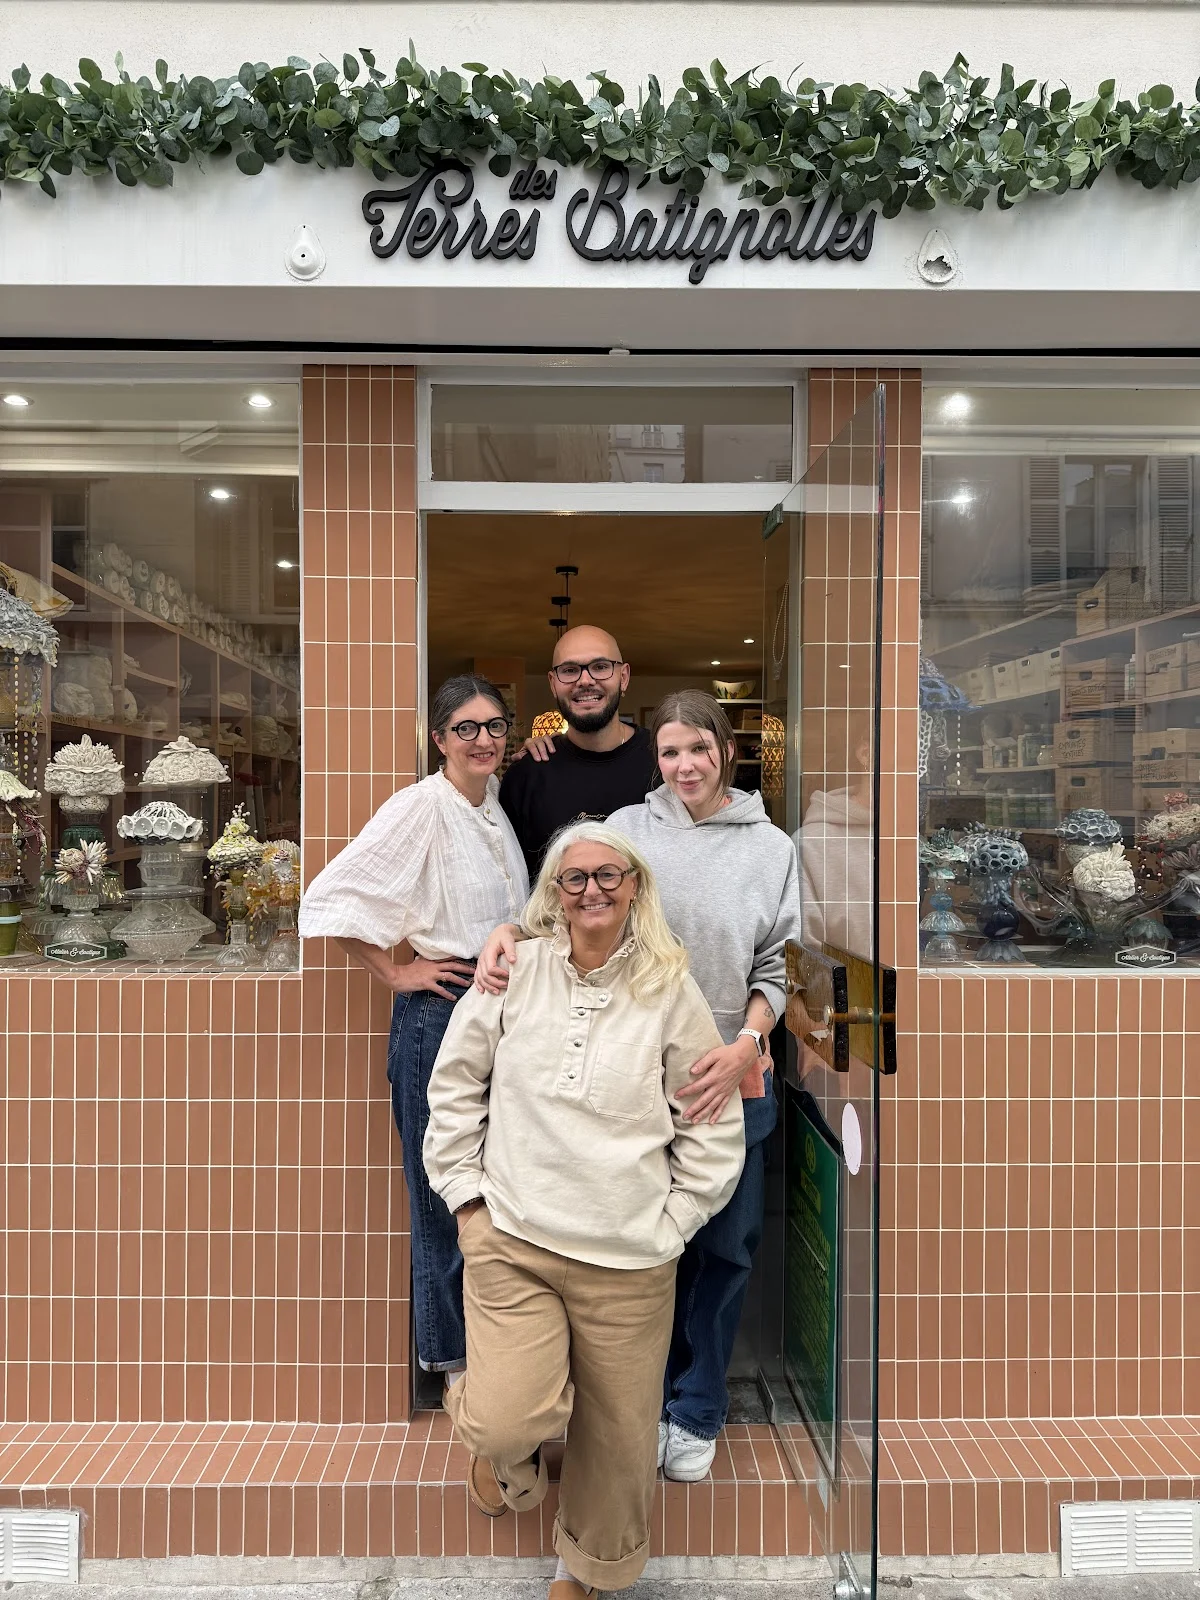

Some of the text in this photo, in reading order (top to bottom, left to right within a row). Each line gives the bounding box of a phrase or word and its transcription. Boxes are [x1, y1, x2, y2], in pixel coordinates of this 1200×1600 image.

[362, 158, 878, 285] Terres des Batignolles
